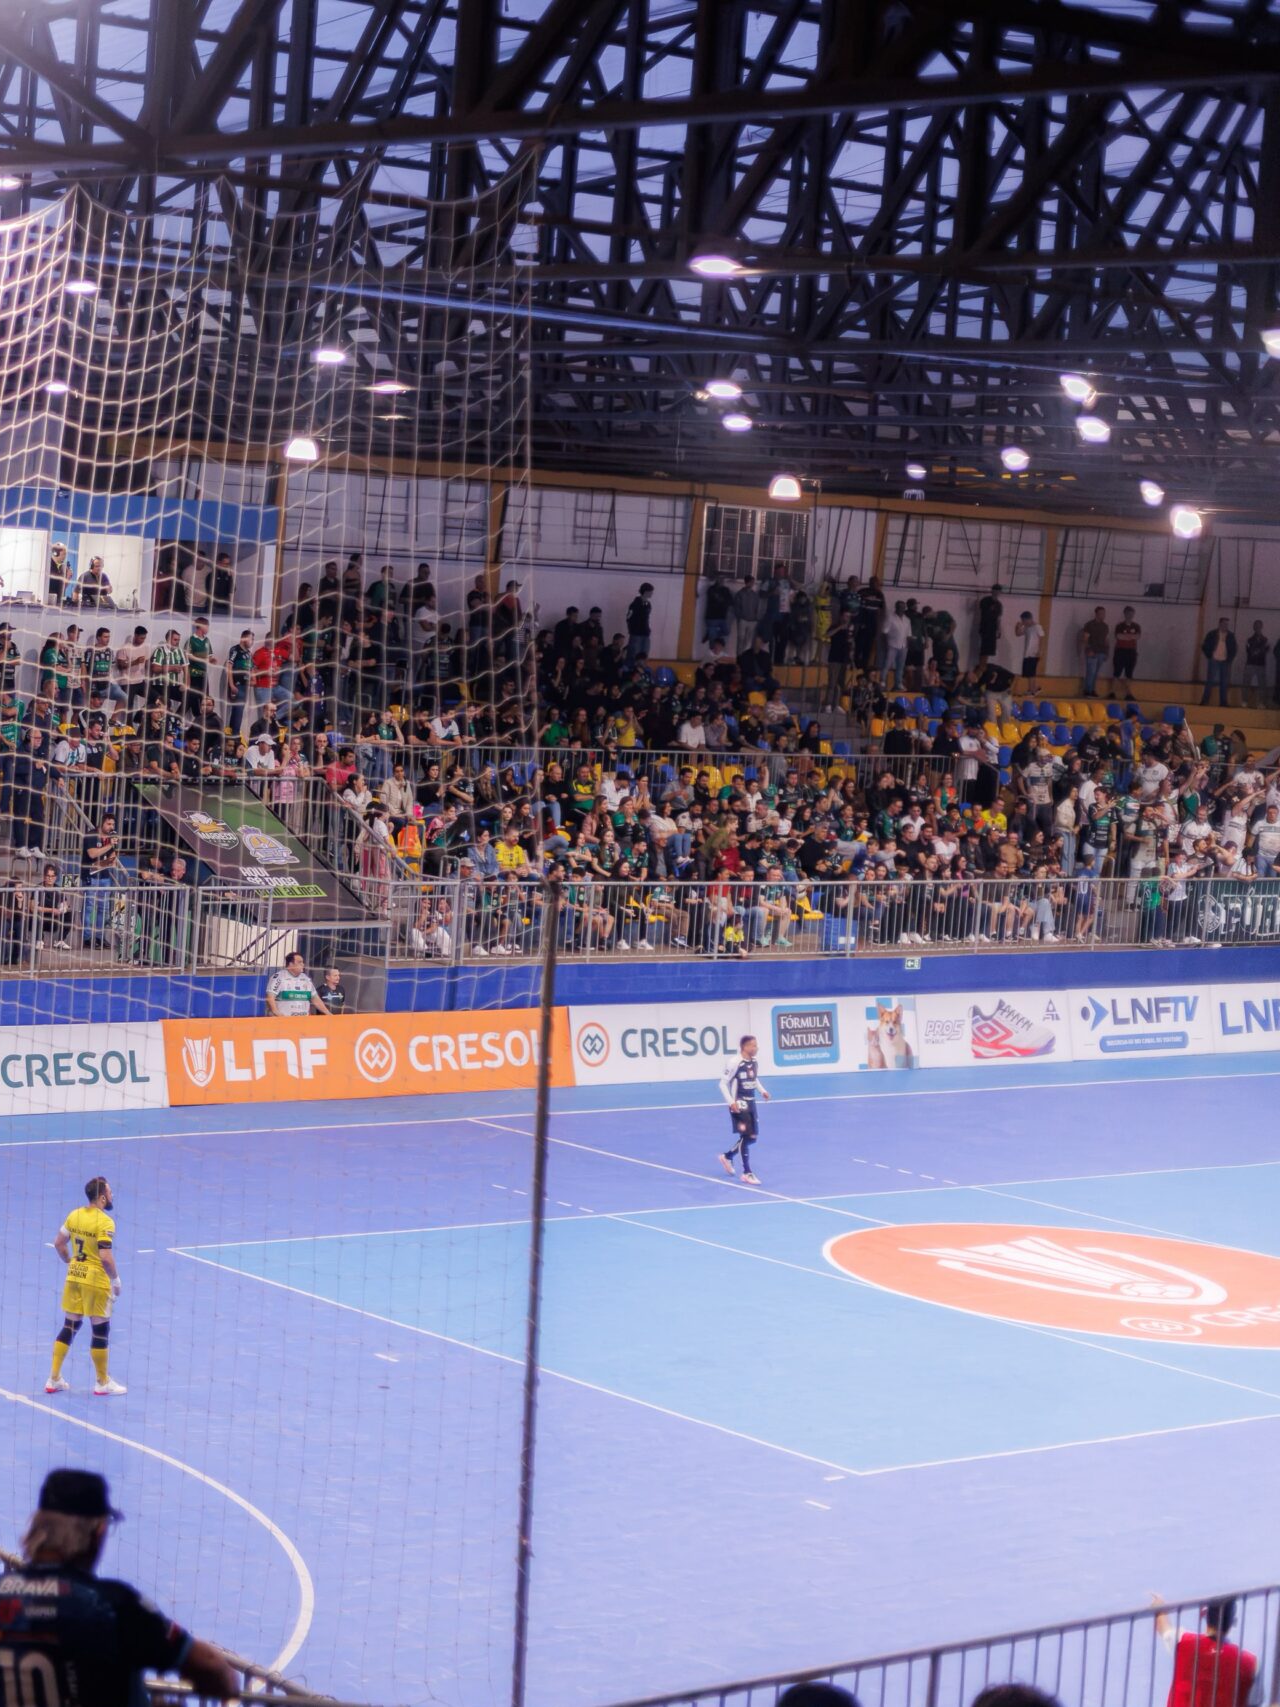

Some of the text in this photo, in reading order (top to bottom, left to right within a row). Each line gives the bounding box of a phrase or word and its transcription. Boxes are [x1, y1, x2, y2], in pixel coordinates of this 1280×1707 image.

[780, 1014, 831, 1030] FÓRMULA
[620, 1026, 738, 1059] CRESOL
[781, 1030, 832, 1048] NATURAL
[0, 1050, 150, 1089] CRESOL
